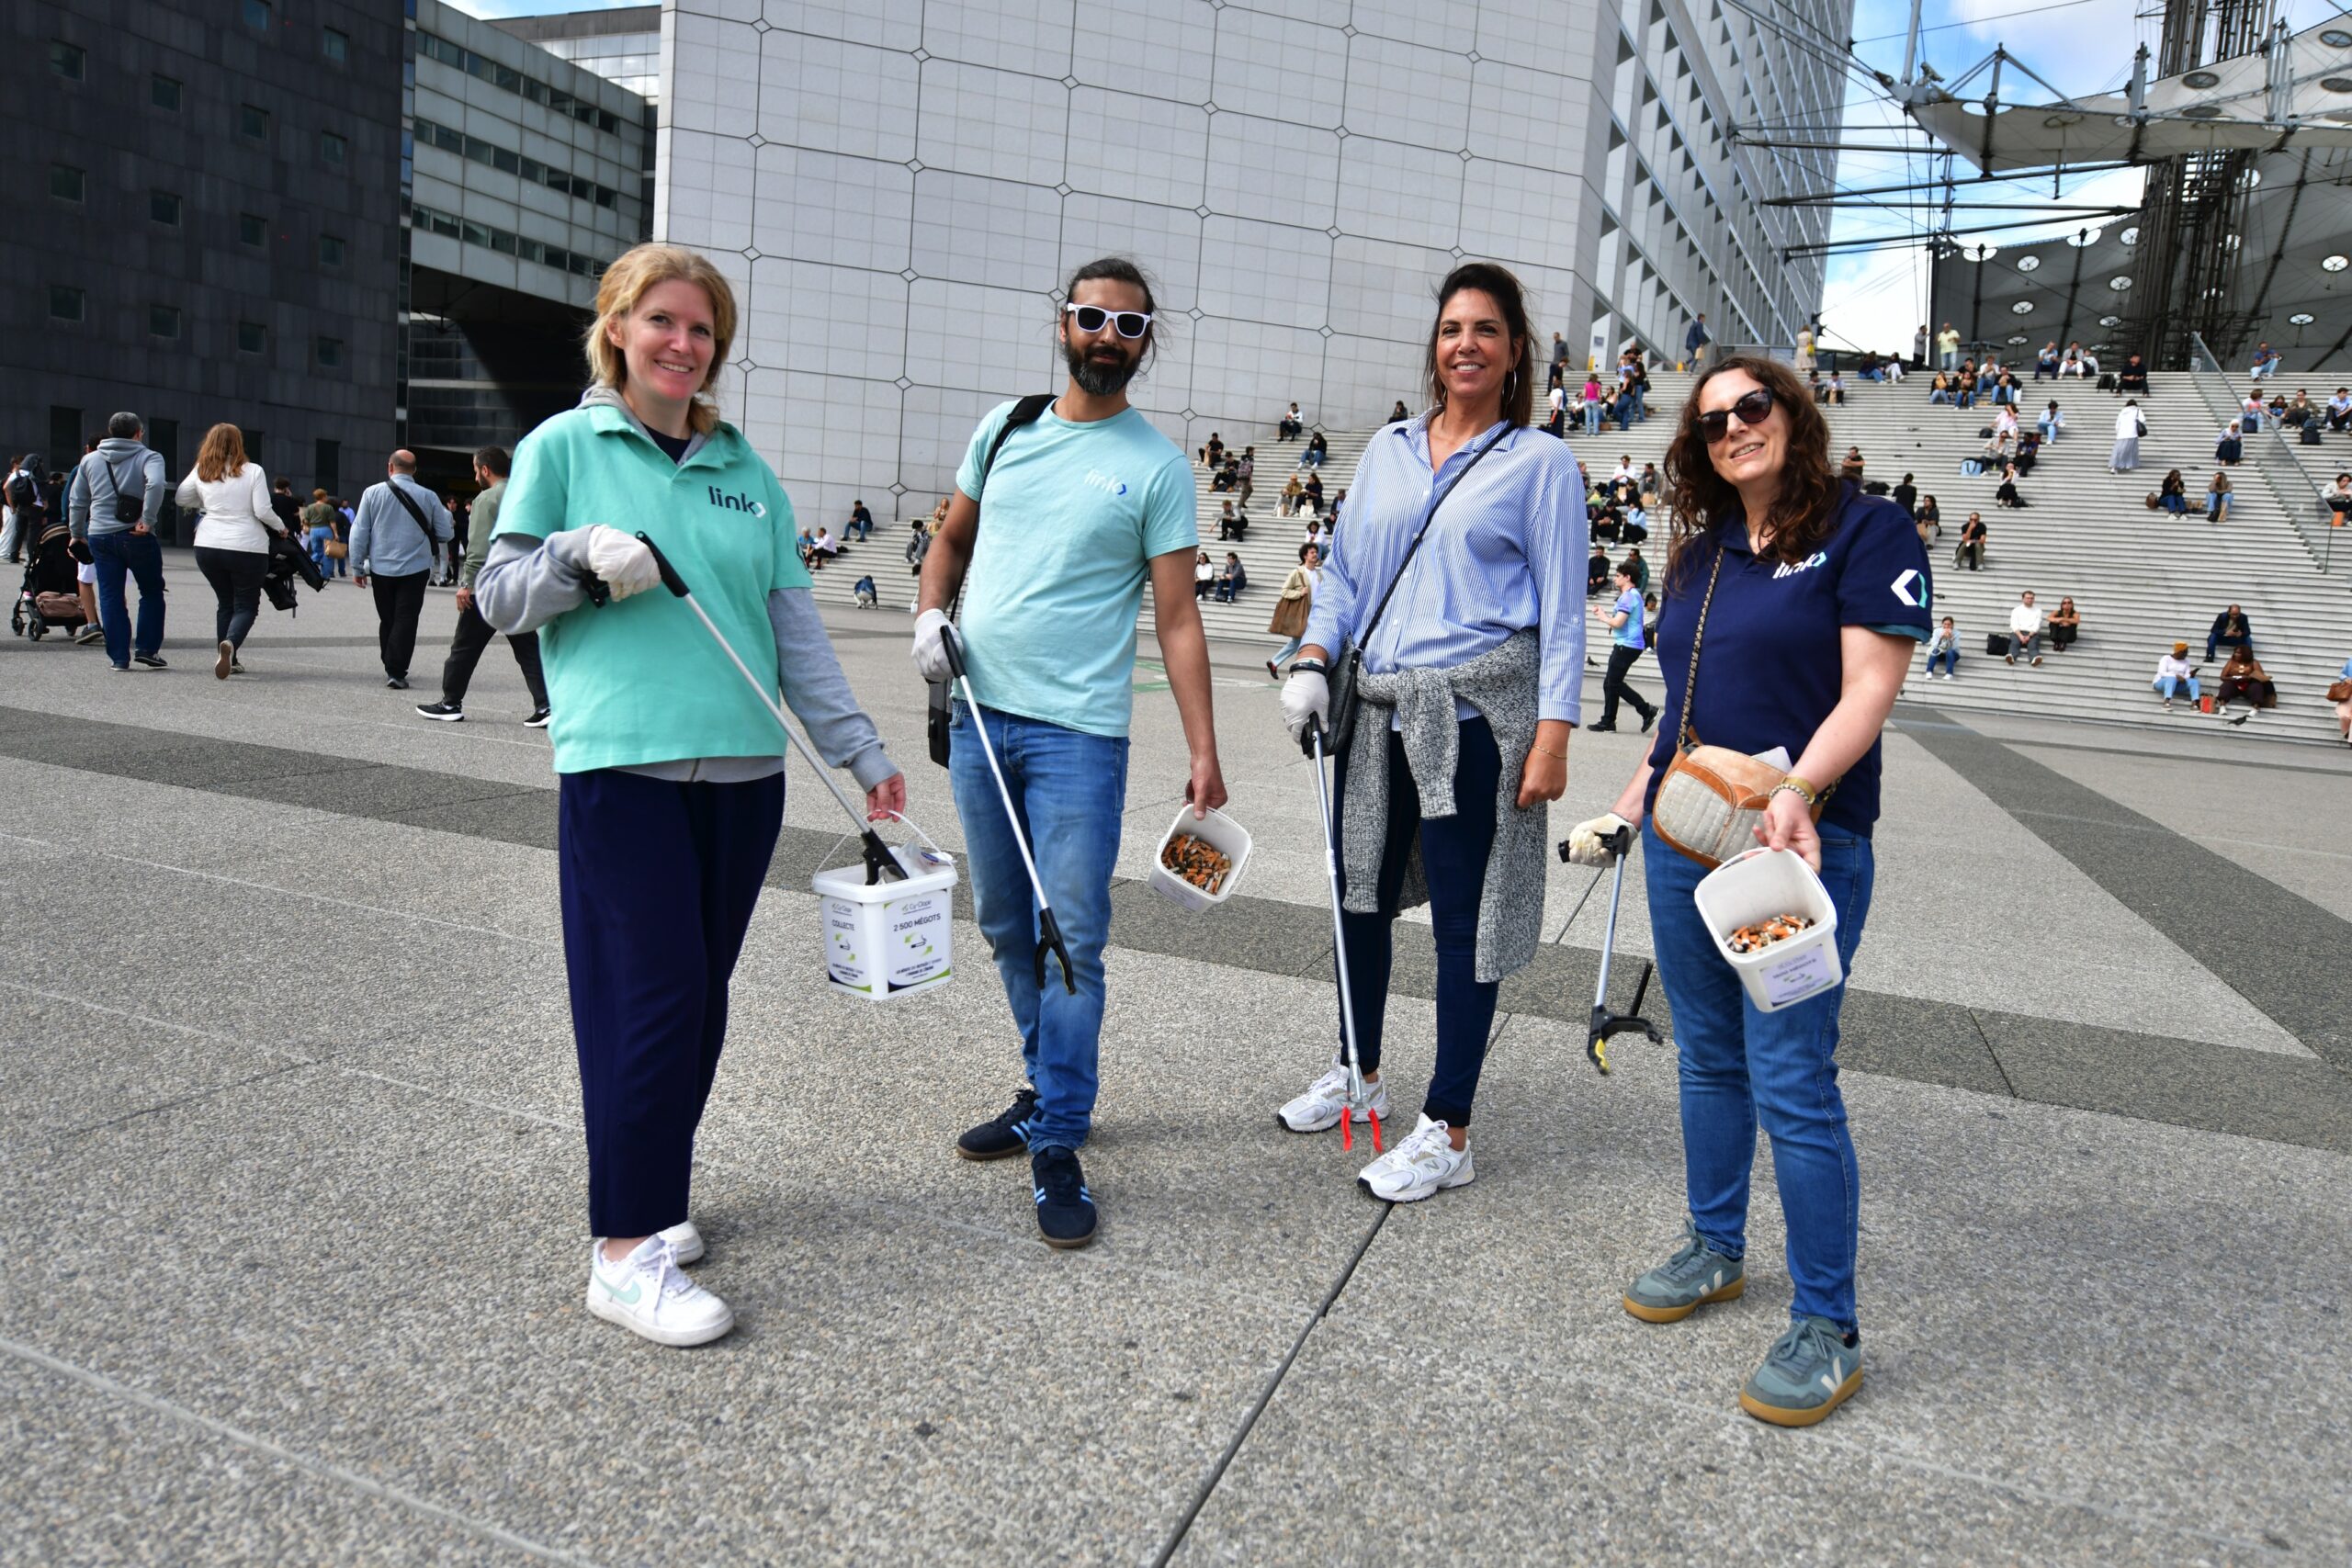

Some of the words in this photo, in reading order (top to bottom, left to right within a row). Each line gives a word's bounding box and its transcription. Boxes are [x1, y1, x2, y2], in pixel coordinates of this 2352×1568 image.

[1084, 468, 1121, 493] link
[708, 485, 756, 515] link
[893, 924, 899, 932] 2
[899, 920, 913, 931] 500
[914, 913, 942, 926] MÉGOTS
